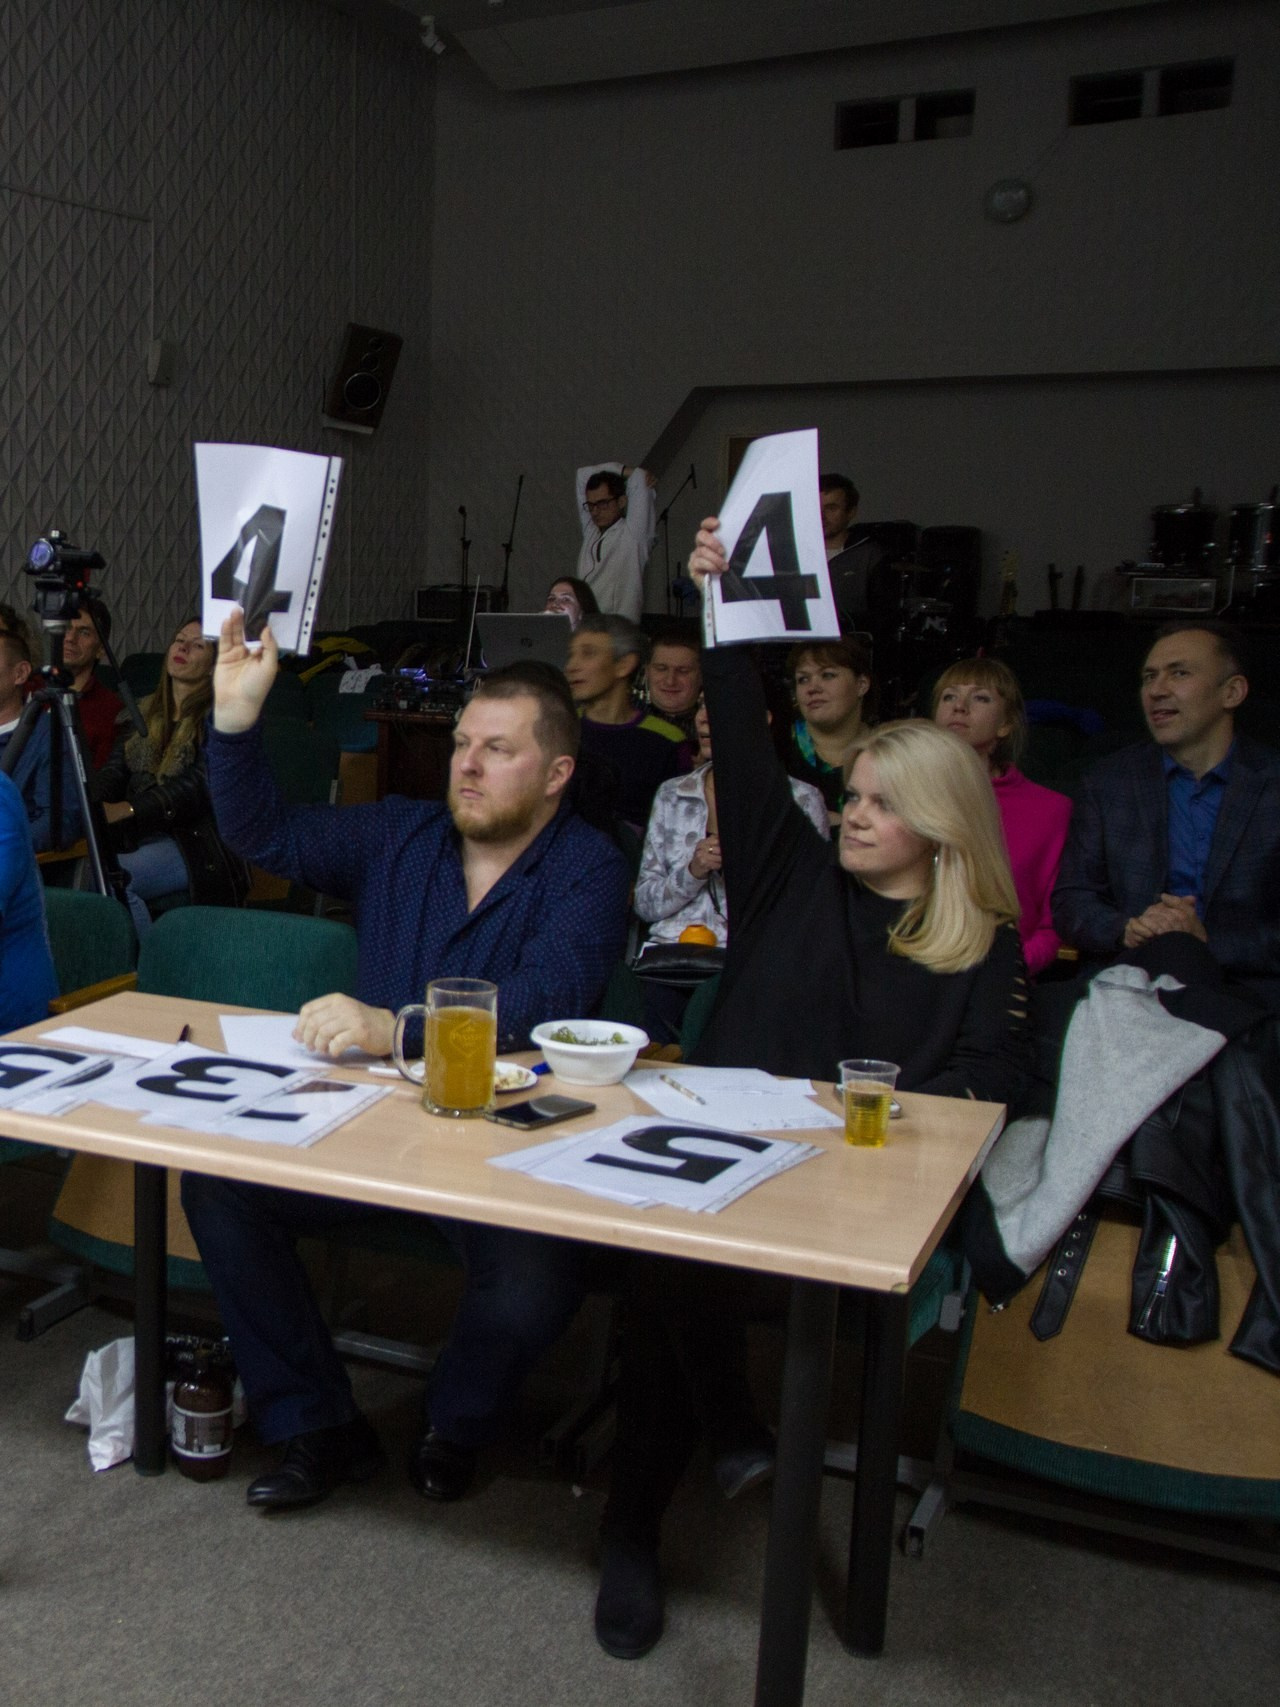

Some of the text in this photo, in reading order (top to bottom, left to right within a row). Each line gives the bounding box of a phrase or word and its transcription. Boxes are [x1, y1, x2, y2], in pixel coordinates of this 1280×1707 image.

[211, 504, 293, 642] 4
[721, 491, 820, 631] 4
[136, 1056, 297, 1102] 3
[585, 1125, 774, 1184] 5
